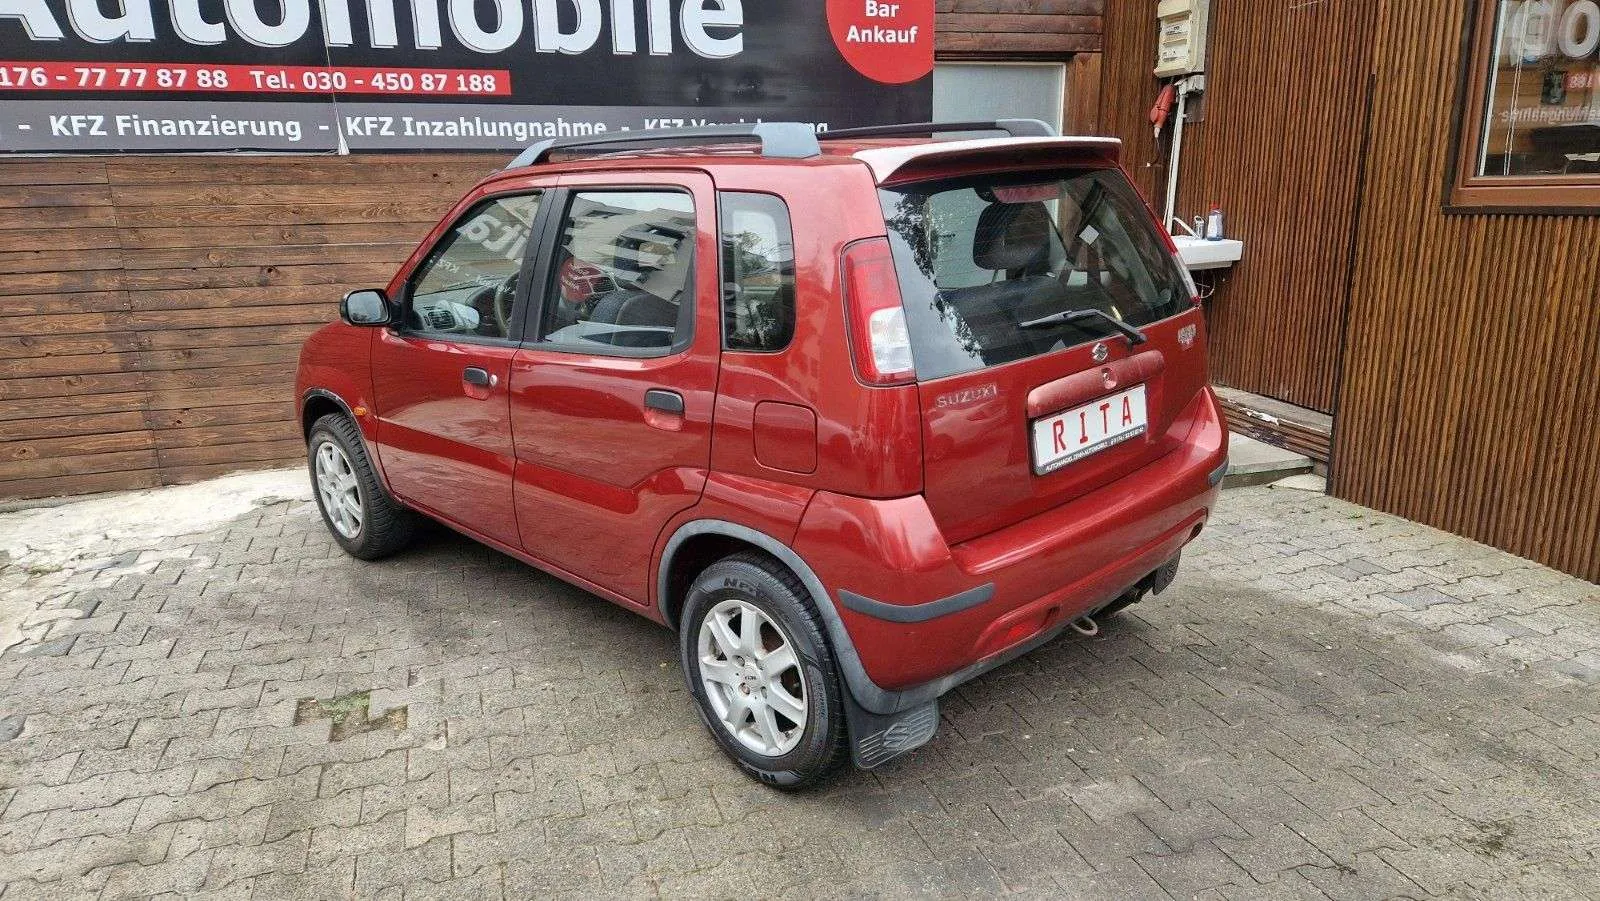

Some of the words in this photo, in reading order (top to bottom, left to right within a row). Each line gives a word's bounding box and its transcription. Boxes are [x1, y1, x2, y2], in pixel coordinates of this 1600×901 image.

[865, 0, 900, 17] Bar
[846, 25, 919, 43] Ankauf
[0, 67, 48, 87] 176
[74, 68, 107, 87] 77
[115, 68, 147, 87] 77
[156, 69, 187, 88] 87
[196, 69, 229, 89] 88
[249, 70, 295, 90] Tel.
[302, 71, 347, 91] 030
[371, 72, 414, 91] 450
[420, 73, 448, 92] 87
[456, 74, 496, 92] 188
[49, 115, 107, 136] KFZ
[115, 114, 302, 142] Finanzierung
[345, 116, 395, 136] KFZ
[402, 116, 607, 142] Inzahlungnahme
[936, 384, 998, 408] SUZUKI
